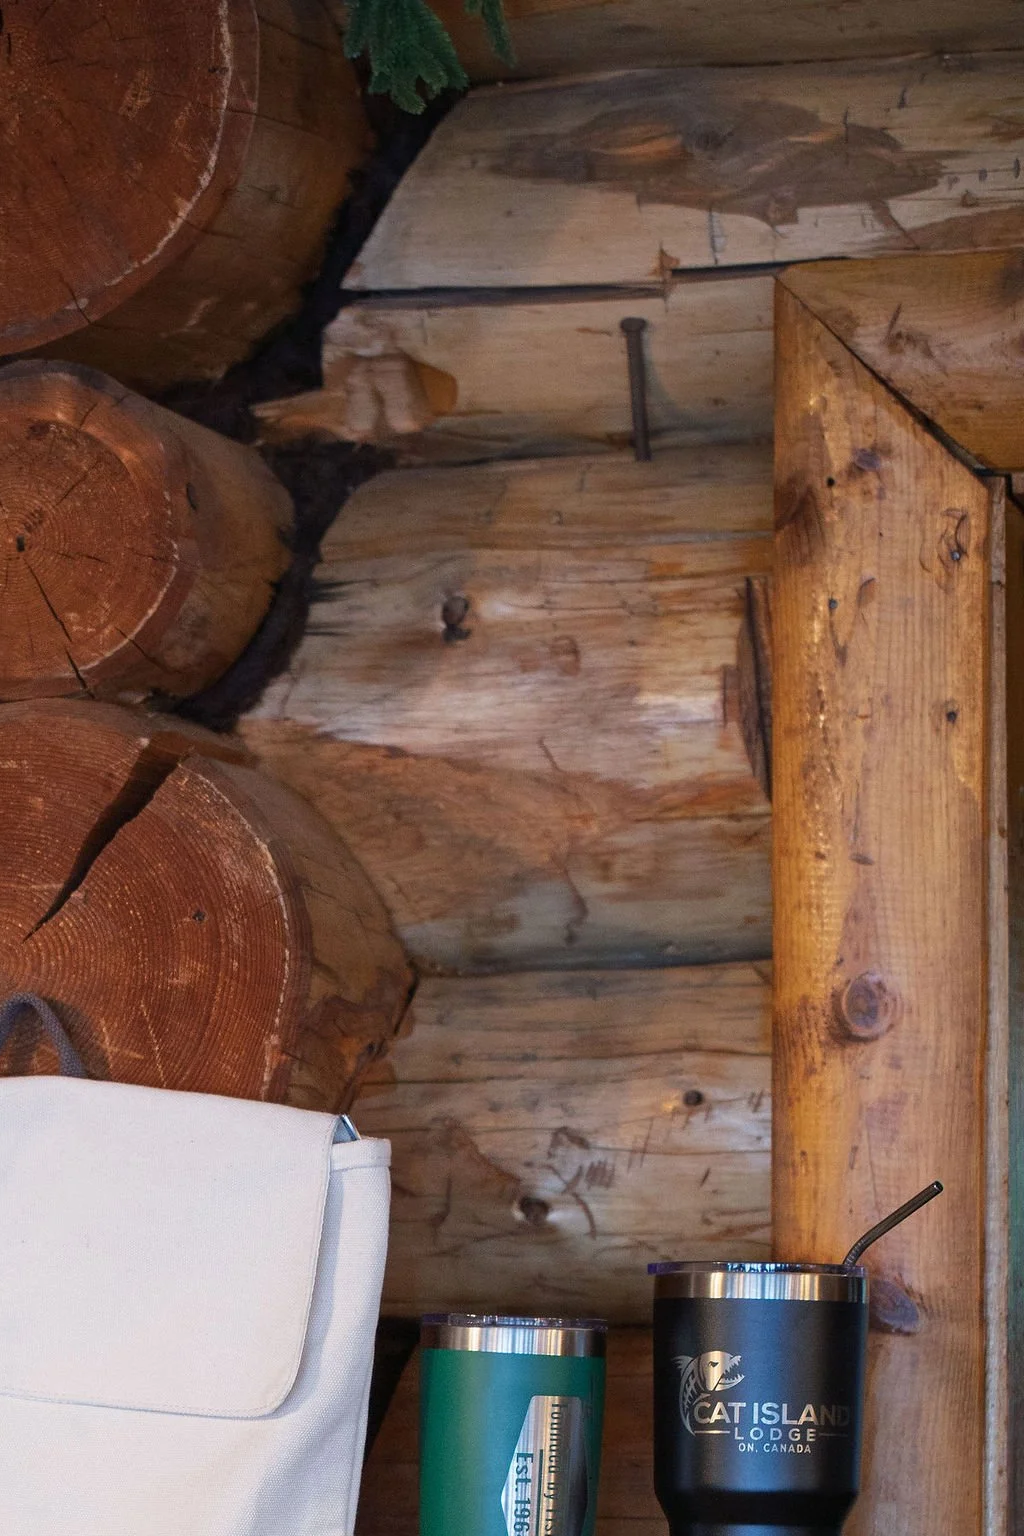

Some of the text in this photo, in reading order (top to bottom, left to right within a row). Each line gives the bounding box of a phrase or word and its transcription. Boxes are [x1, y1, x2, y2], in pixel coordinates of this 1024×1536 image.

[693, 1401, 850, 1427] CAT ISLAND
[548, 1402, 568, 1474] Founded
[734, 1426, 817, 1443] LODGE
[763, 1442, 812, 1455] CANADA
[544, 1481, 562, 1500] by
